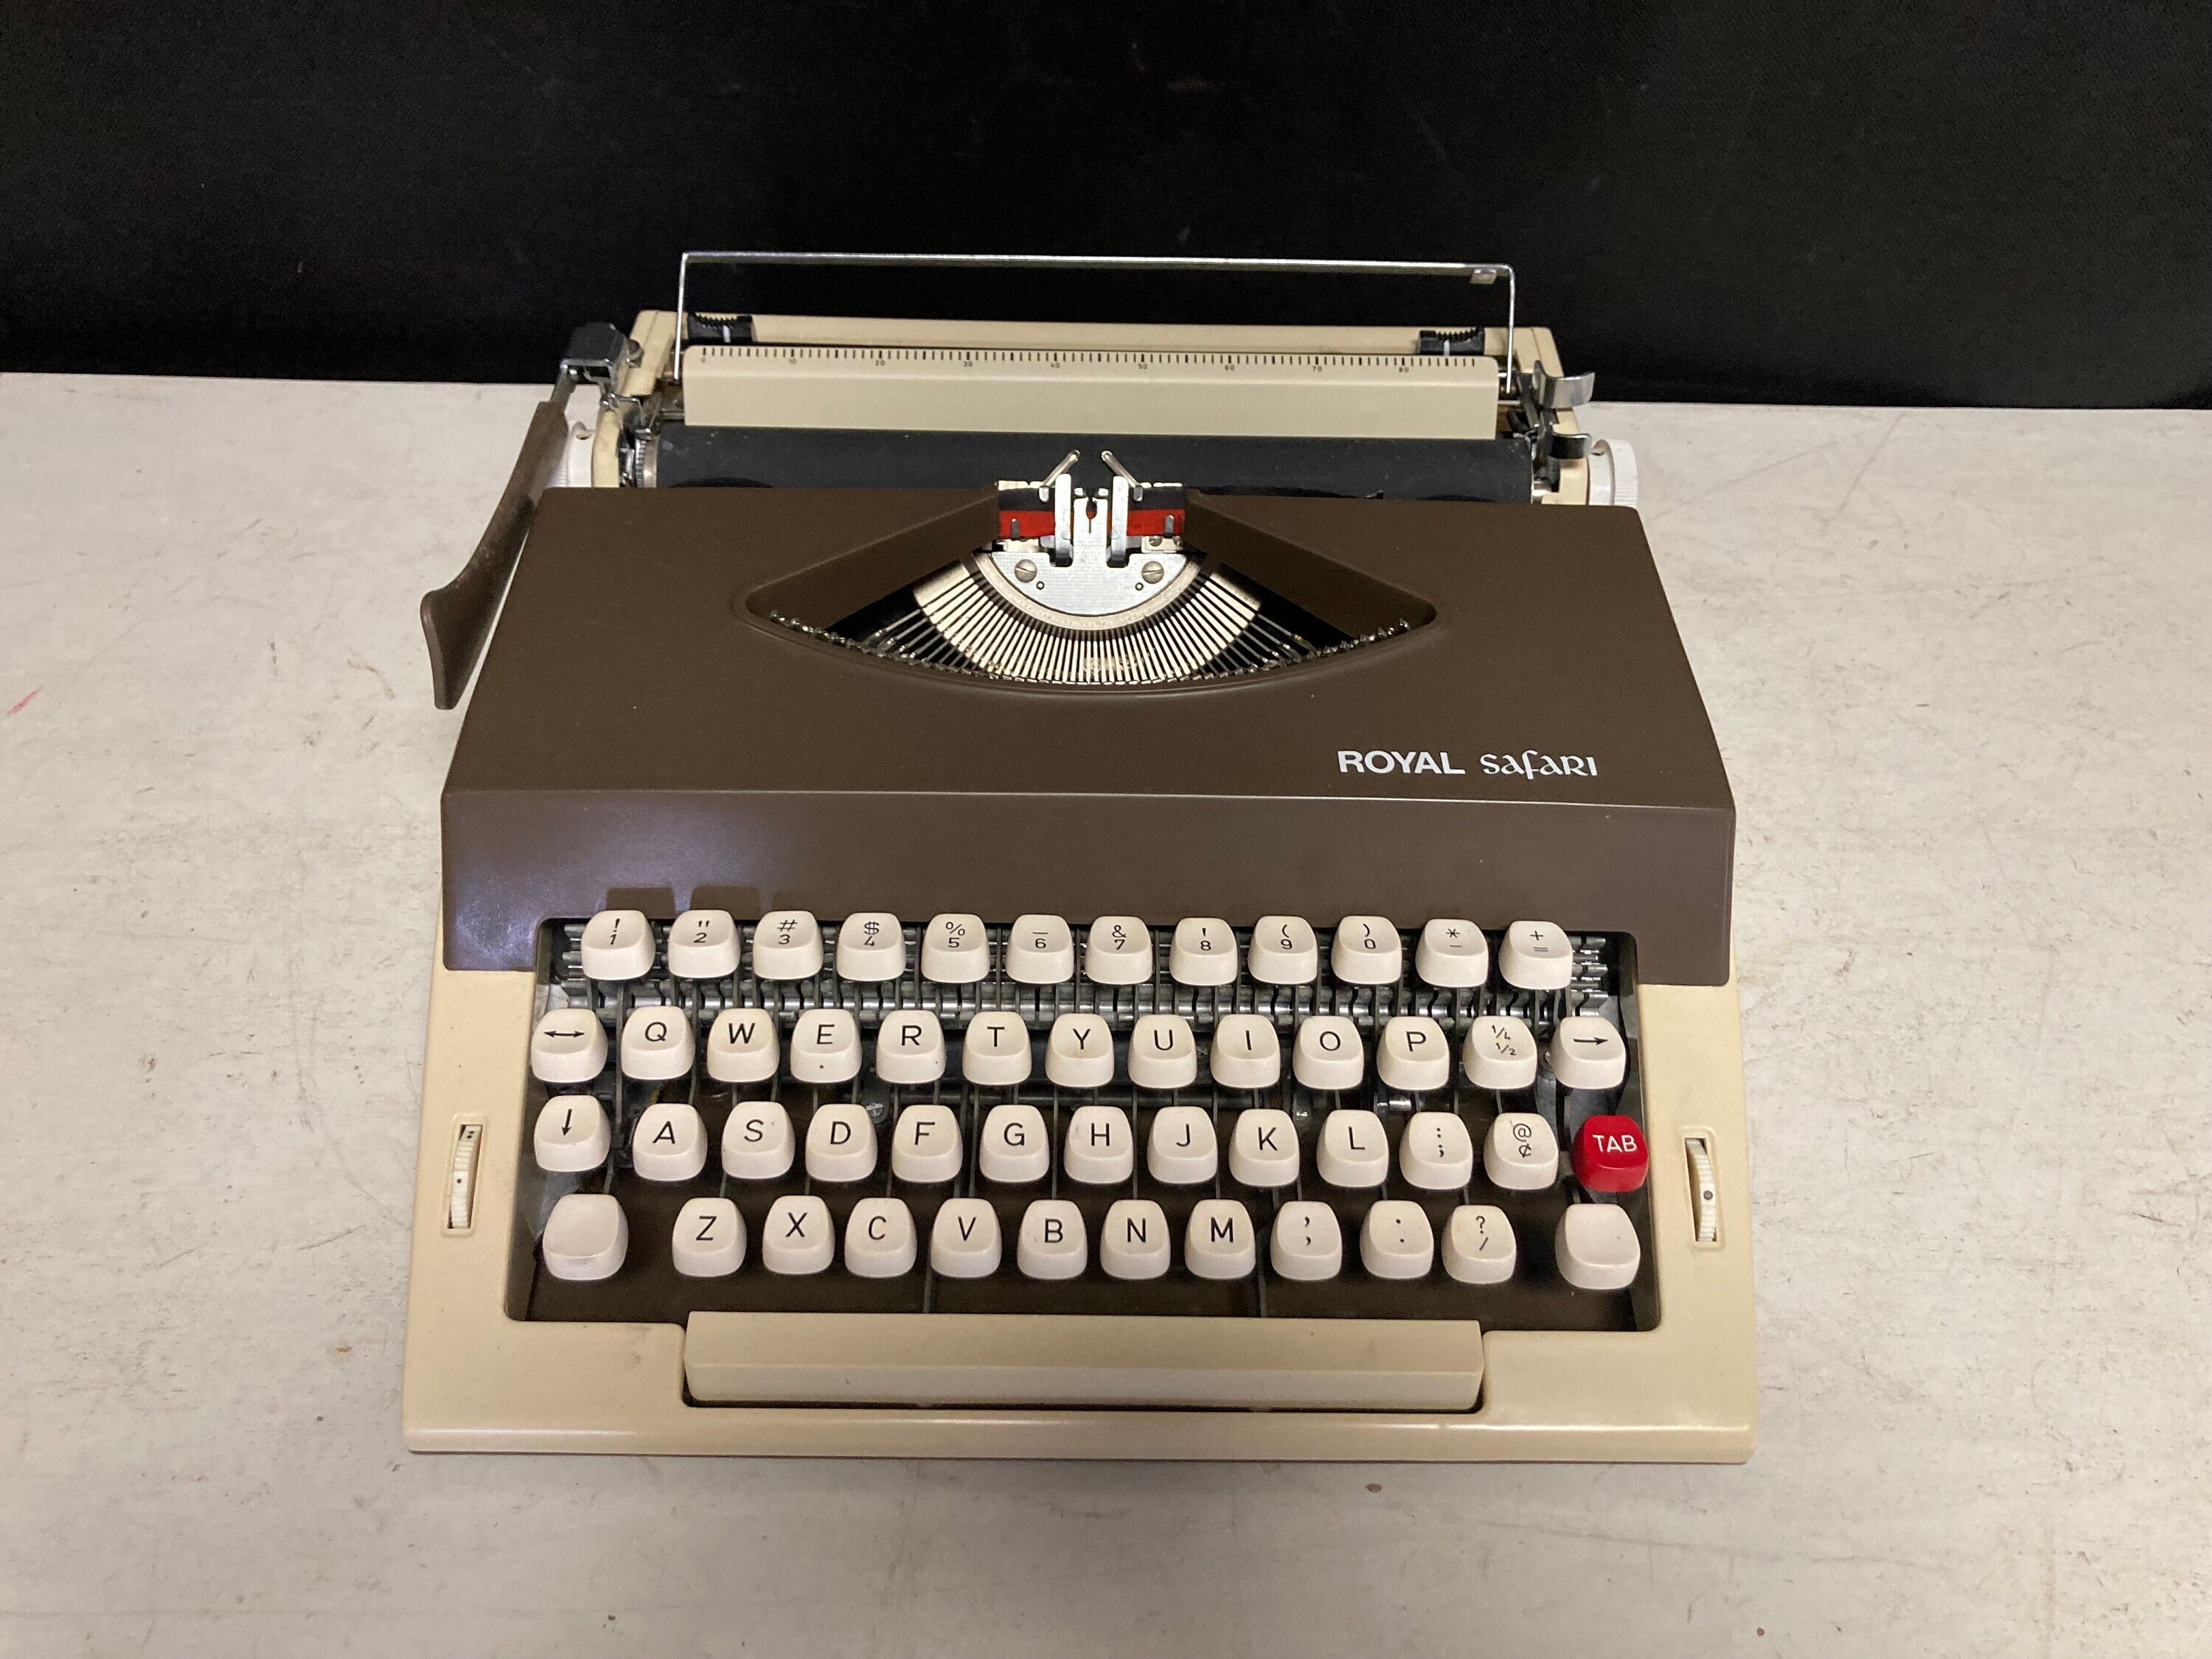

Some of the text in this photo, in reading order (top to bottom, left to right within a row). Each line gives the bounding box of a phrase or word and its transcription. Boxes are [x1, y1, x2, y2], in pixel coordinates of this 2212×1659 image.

[1338, 750, 1466, 774] ROYAL
[613, 918, 621, 933] !
[777, 919, 798, 932] #
[863, 921, 880, 936] $
[945, 921, 966, 936] %
[1112, 925, 1127, 939] &
[1529, 930, 1544, 941] +
[610, 933, 617, 945] 1
[693, 932, 707, 944] 2
[778, 933, 790, 945] 3
[863, 935, 876, 947] 4
[947, 937, 960, 948] 5
[1034, 938, 1047, 949] 6
[1114, 939, 1125, 950] 7
[1200, 940, 1212, 951] 8
[1280, 939, 1293, 950] 9
[644, 1021, 667, 1043] Q
[728, 1022, 756, 1045] W
[816, 1023, 835, 1045] E
[901, 1025, 922, 1046] R
[987, 1026, 1005, 1048] T
[1072, 1028, 1091, 1051] Y
[1153, 1029, 1174, 1051] U
[1245, 1030, 1252, 1051] I
[1319, 1031, 1341, 1051] O
[1405, 1031, 1427, 1052] P
[652, 1121, 676, 1144] A
[743, 1119, 764, 1143] S
[830, 1121, 852, 1145] D
[914, 1121, 936, 1146] F
[1004, 1122, 1025, 1147] G
[1091, 1122, 1110, 1147] H
[1175, 1124, 1191, 1147] J
[1258, 1127, 1279, 1151] K
[1348, 1126, 1366, 1150] L
[1512, 1123, 1532, 1143] @
[1592, 1134, 1638, 1153] TAB
[695, 1215, 717, 1241] Z
[785, 1212, 808, 1238] X
[868, 1215, 887, 1241] C
[958, 1216, 976, 1242] V
[1044, 1218, 1063, 1244] B
[1127, 1217, 1147, 1243] N
[1211, 1217, 1234, 1243] M
[1475, 1215, 1486, 1234] ?
[1478, 1237, 1489, 1251] /
